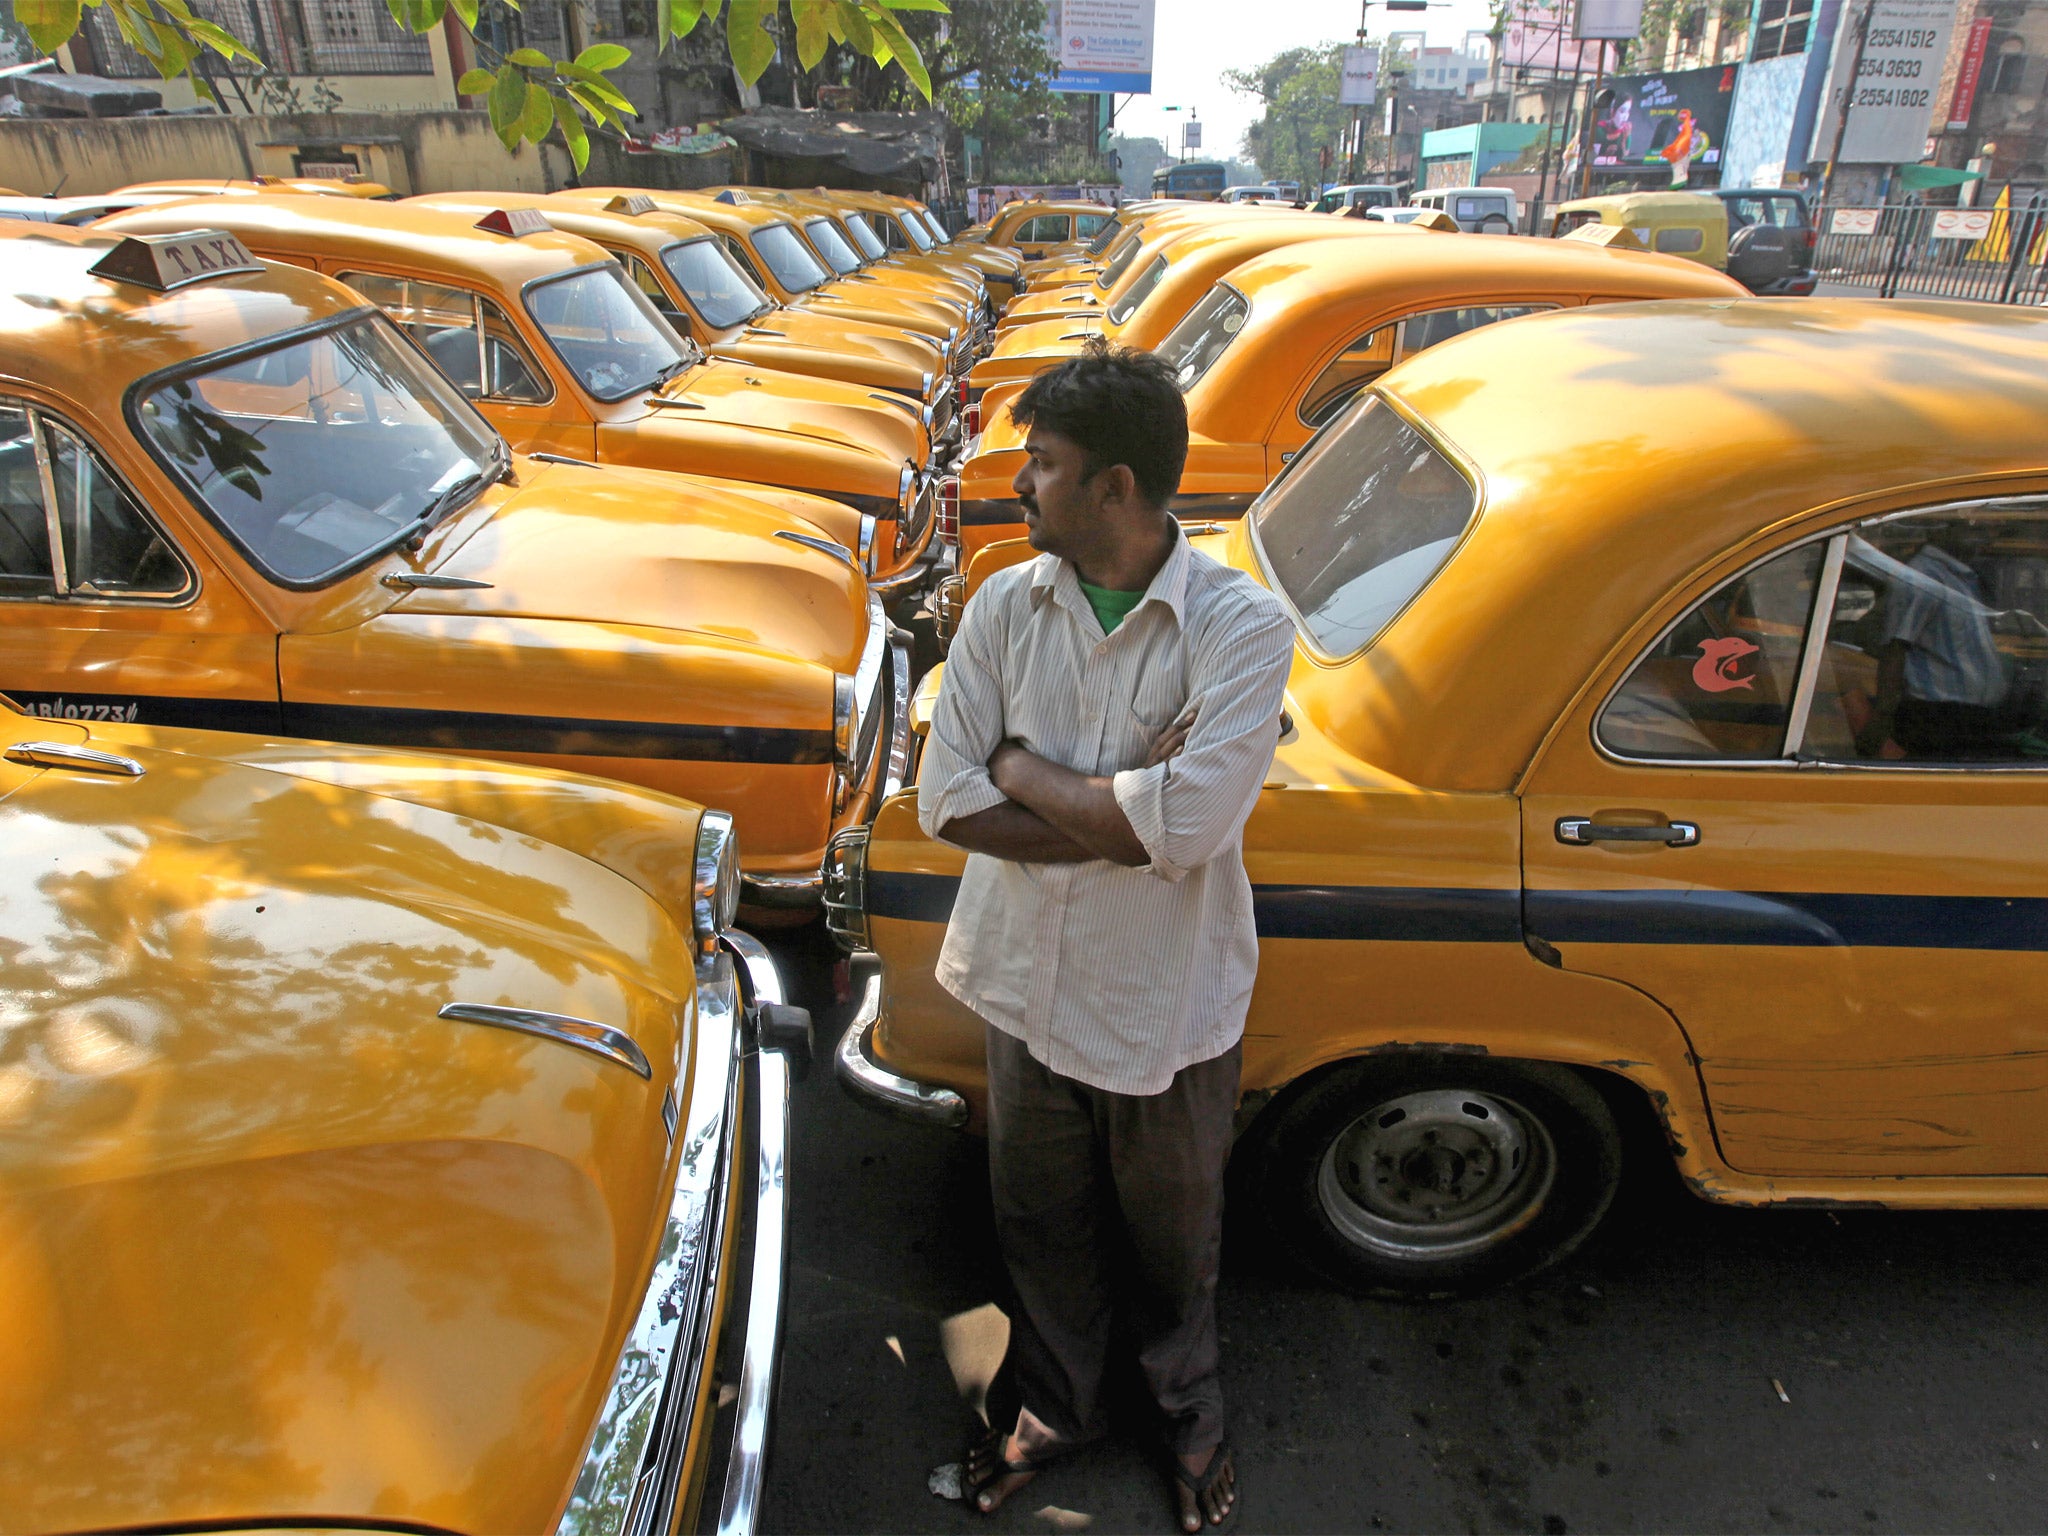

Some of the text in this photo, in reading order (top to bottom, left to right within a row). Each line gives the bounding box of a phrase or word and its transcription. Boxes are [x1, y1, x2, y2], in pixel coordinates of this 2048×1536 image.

[304, 166, 336, 178] METER
[509, 209, 543, 229] TAXI
[1579, 225, 1614, 239] TAXI
[164, 238, 250, 274] TAXI
